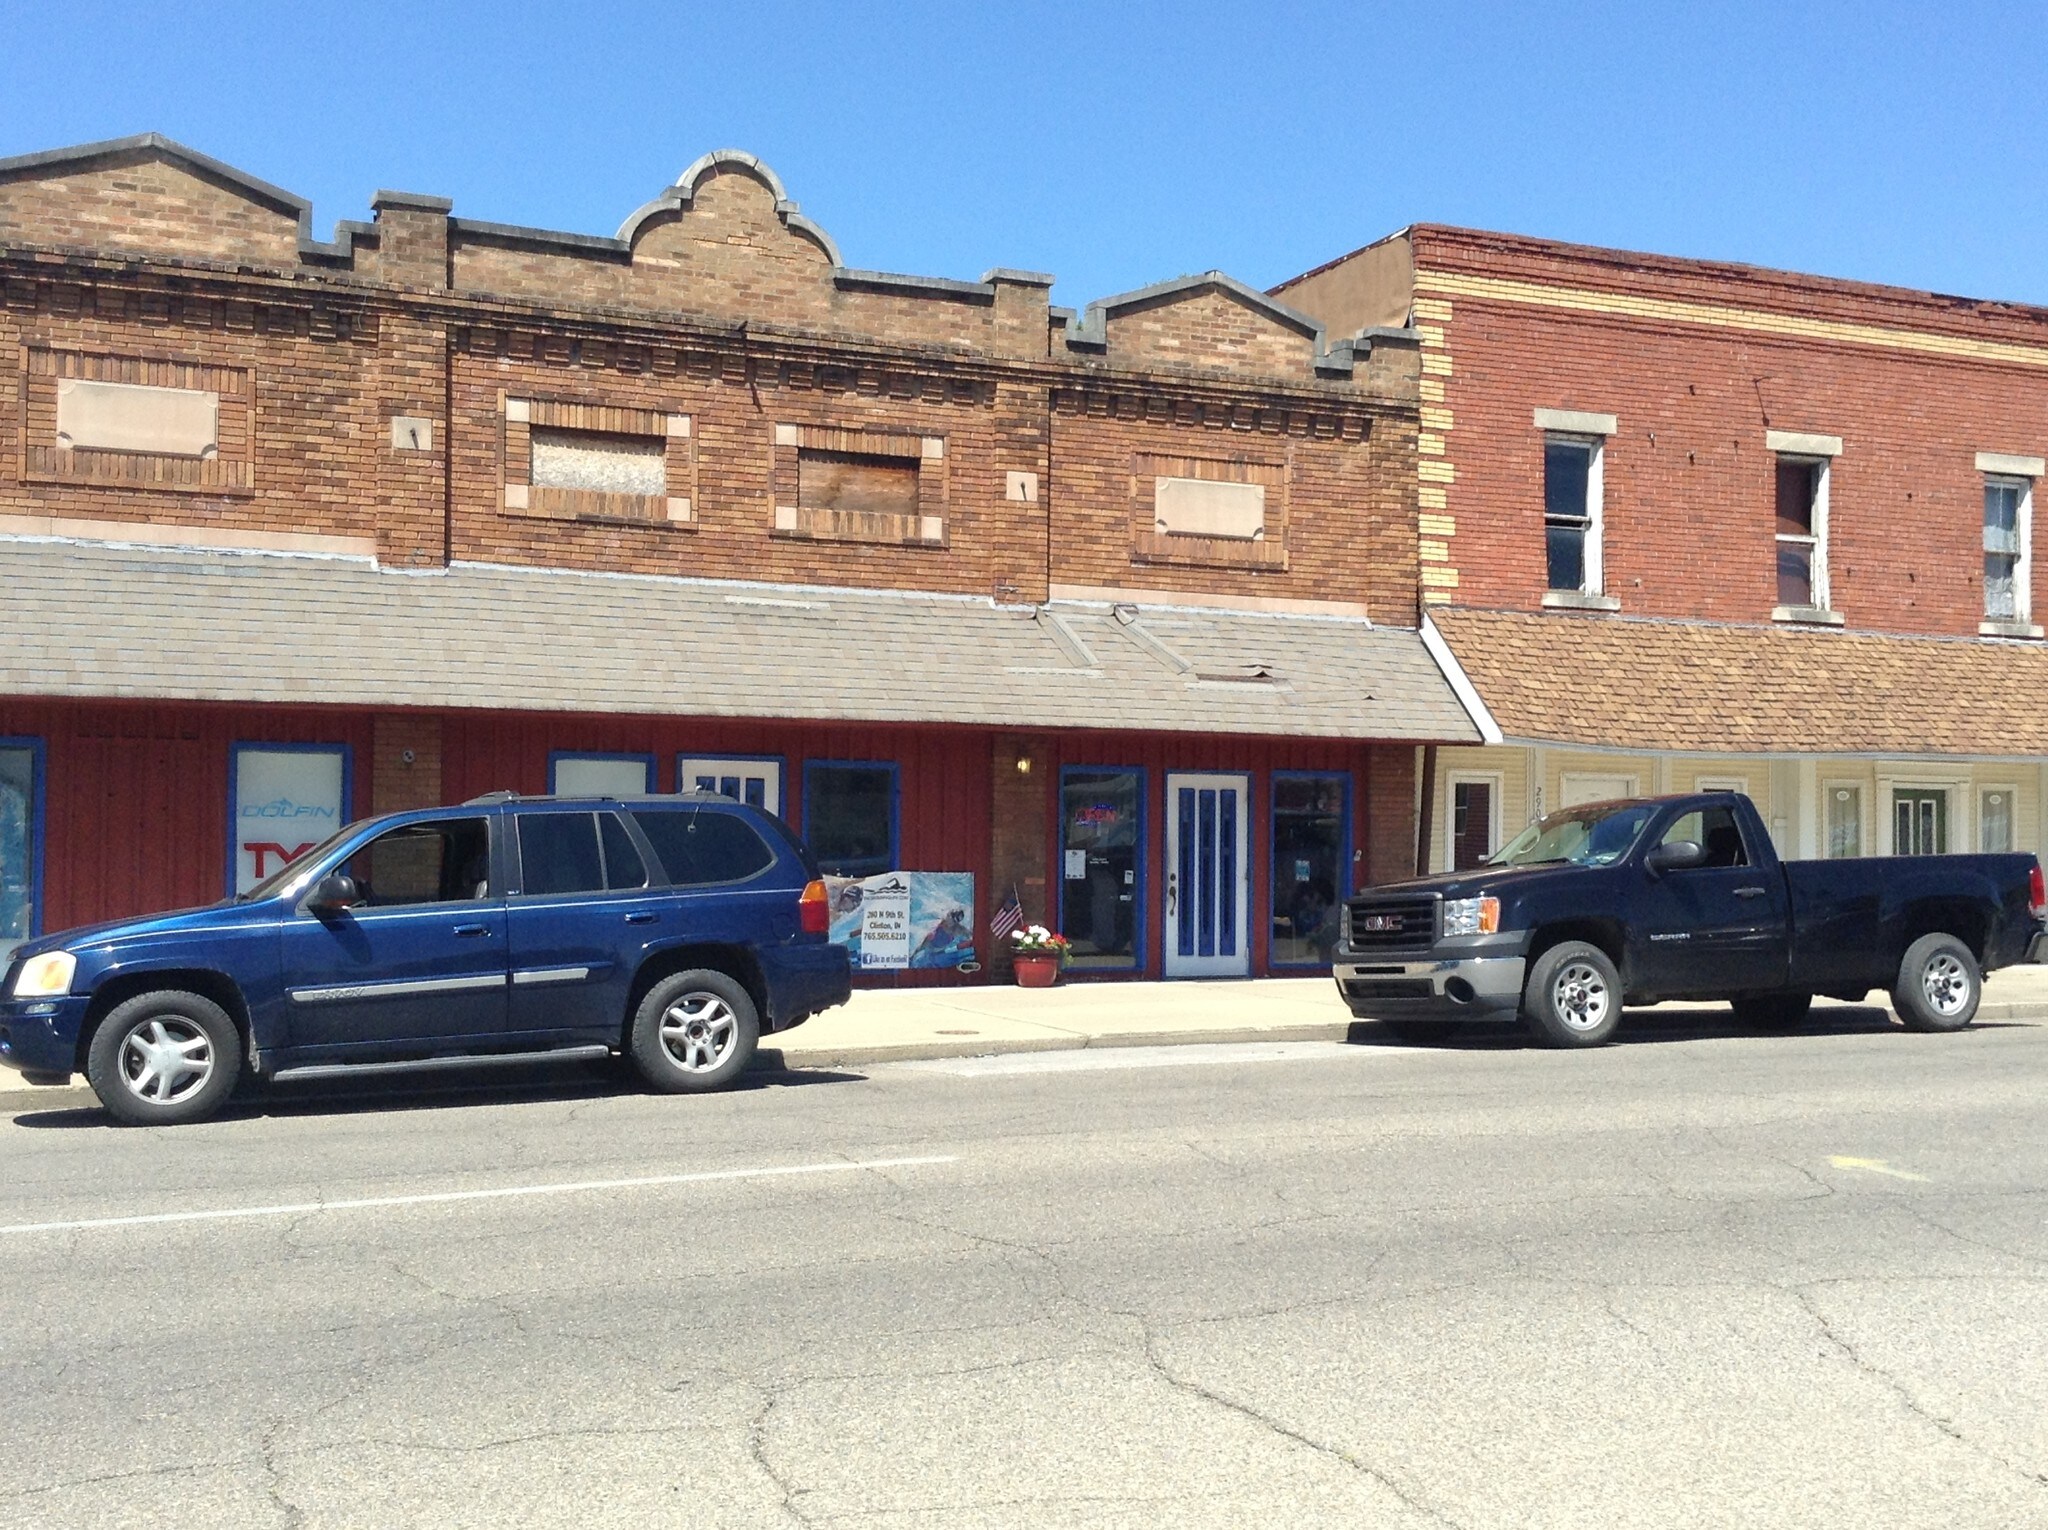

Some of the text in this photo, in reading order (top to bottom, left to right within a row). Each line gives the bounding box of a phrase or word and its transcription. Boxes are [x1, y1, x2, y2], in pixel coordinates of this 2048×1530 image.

[242, 804, 335, 818] DOLFIN
[243, 843, 317, 879] TY
[1365, 915, 1403, 930] GMC
